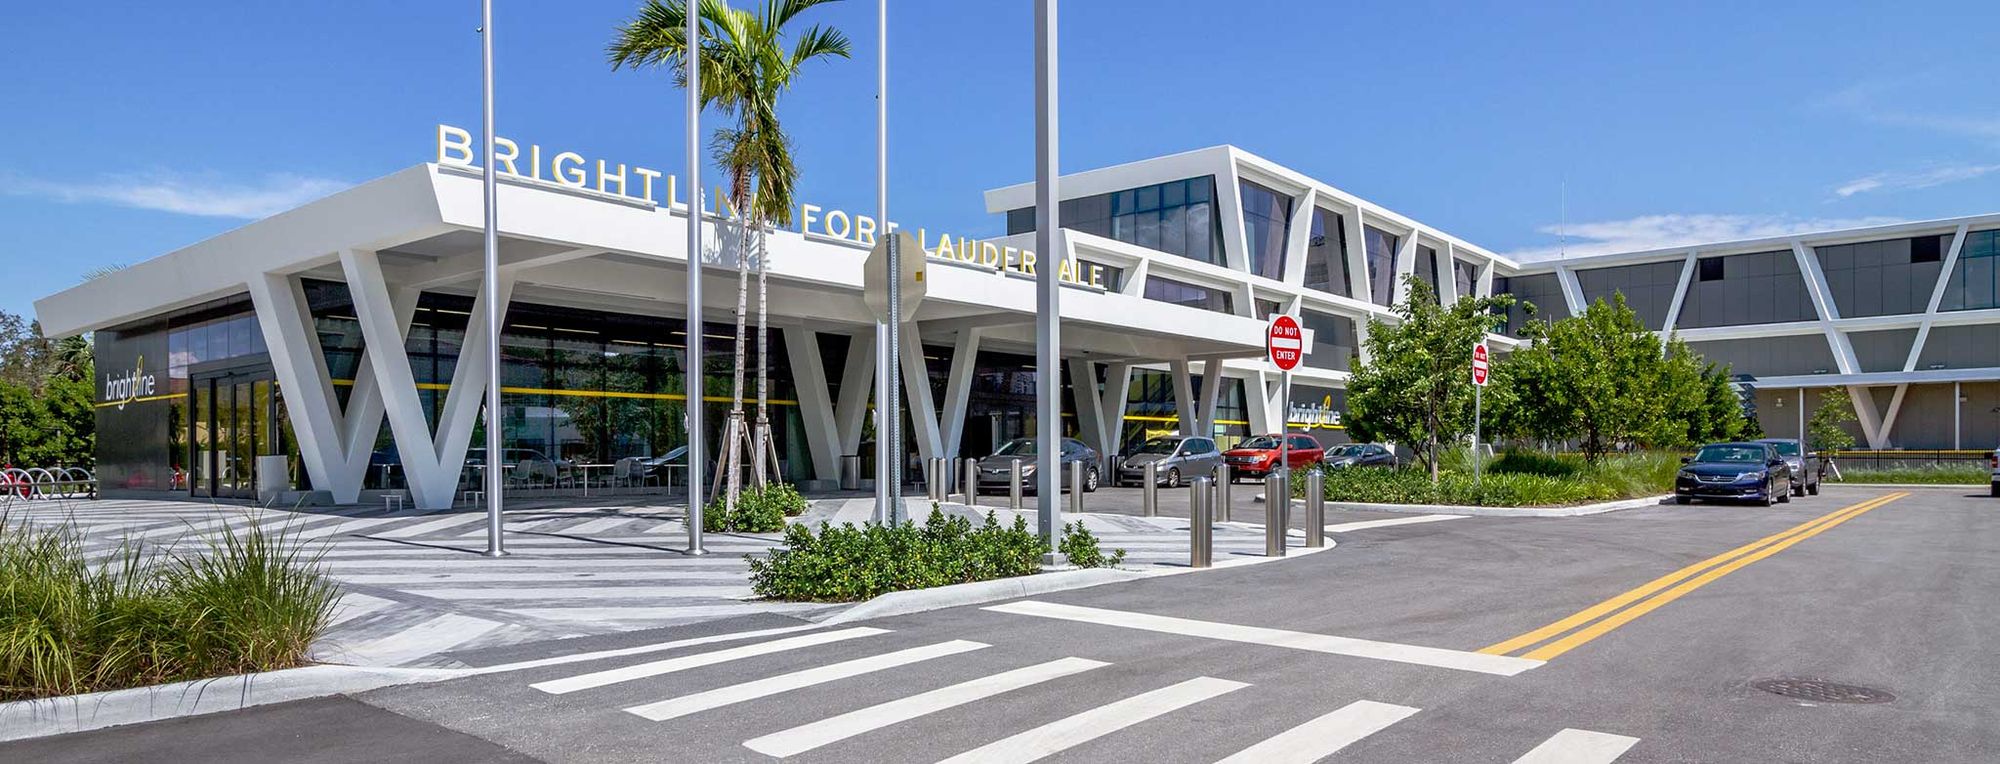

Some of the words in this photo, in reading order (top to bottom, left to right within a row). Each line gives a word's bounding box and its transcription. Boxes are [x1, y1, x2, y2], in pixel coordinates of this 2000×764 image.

[917, 228, 1105, 288] LAUDERALE
[1274, 325, 1283, 335] DO
[1284, 327, 1298, 336] NOT
[1276, 350, 1296, 360] ENTER
[105, 355, 155, 410] brightline
